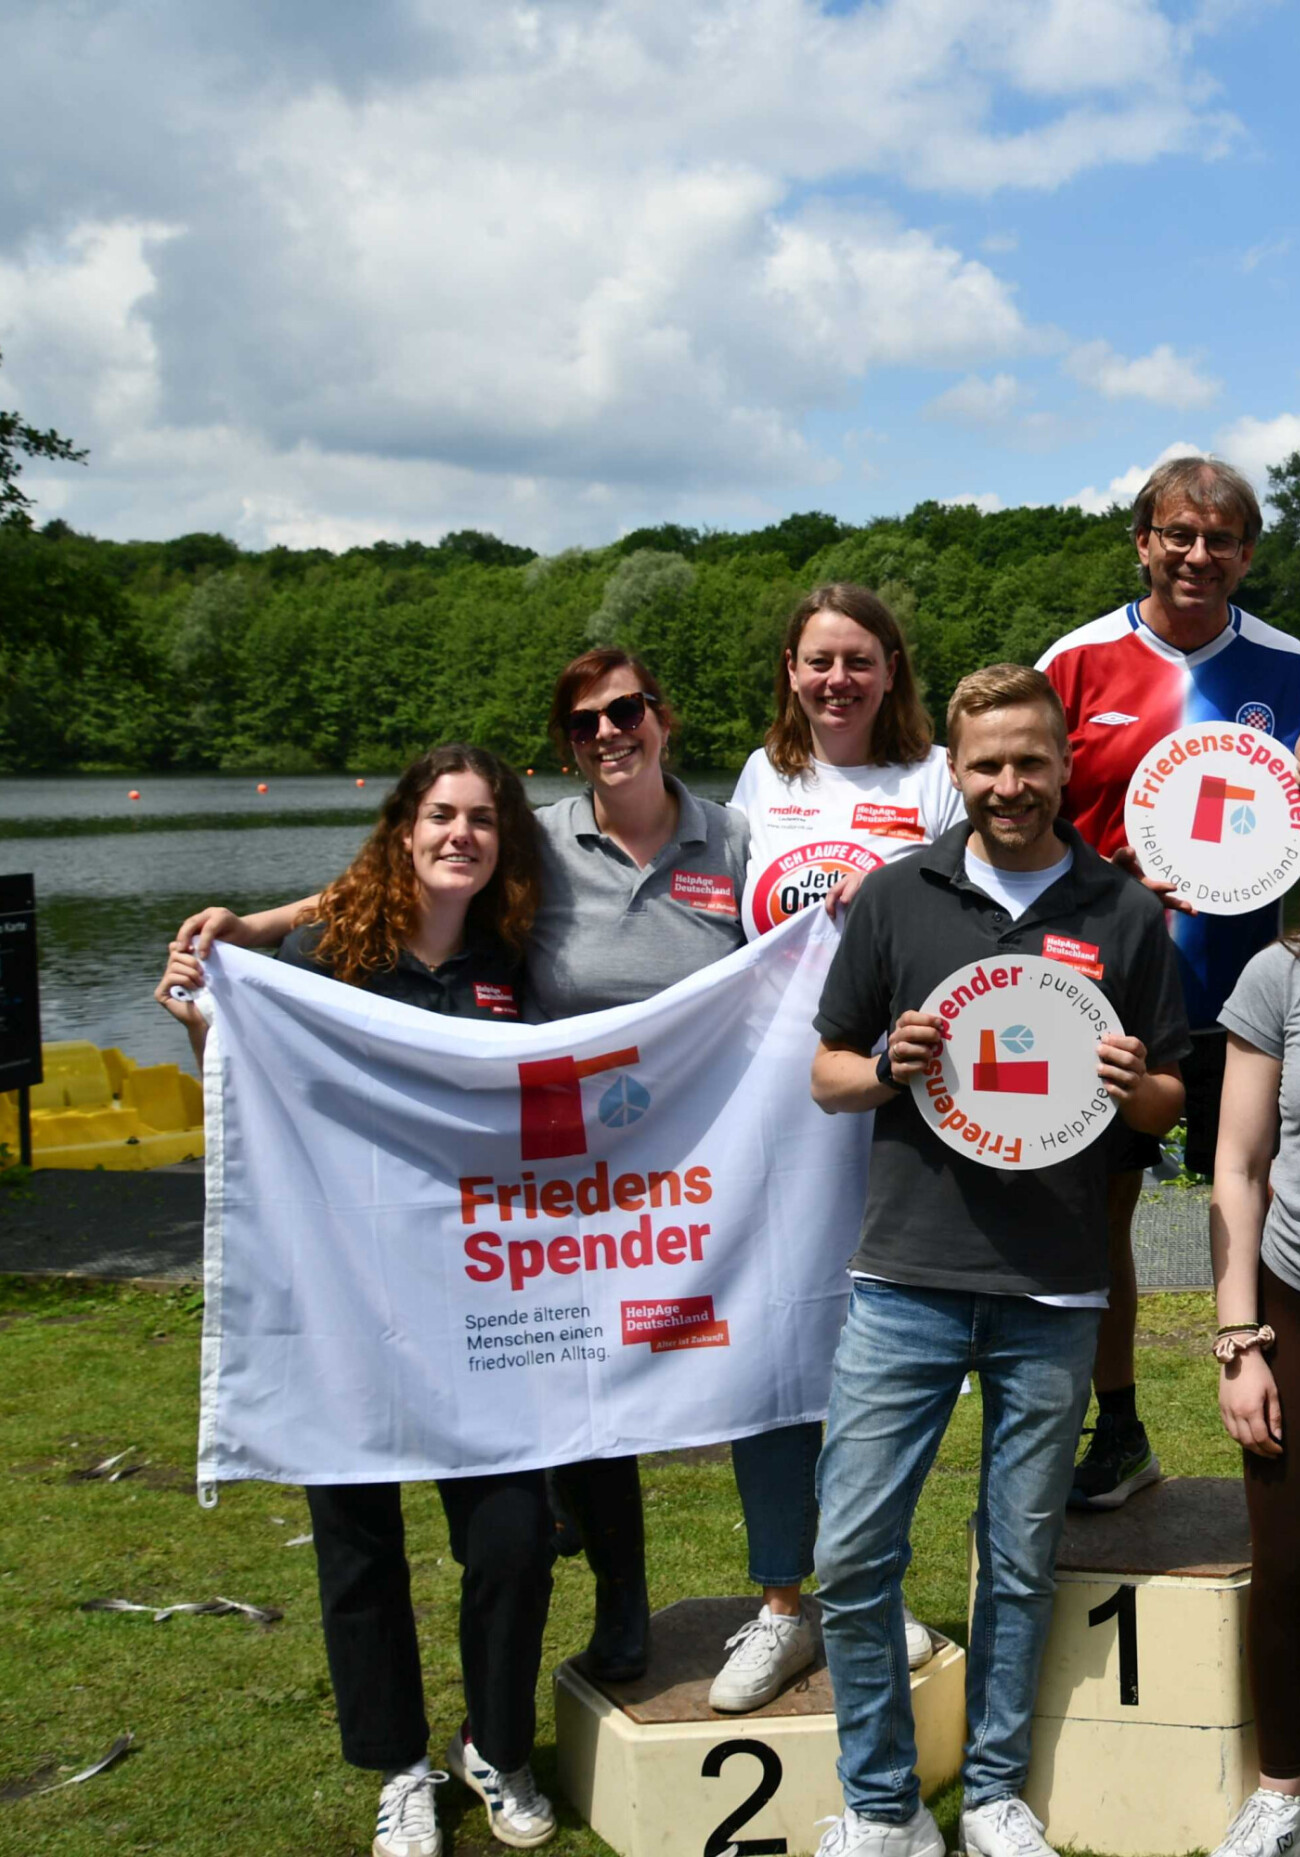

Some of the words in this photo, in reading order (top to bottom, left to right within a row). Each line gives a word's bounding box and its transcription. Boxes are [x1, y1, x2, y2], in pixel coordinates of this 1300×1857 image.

[855, 813, 915, 824] Deutschland
[856, 805, 897, 816] HelpAge
[778, 853, 803, 872] ICH
[806, 844, 850, 861] LAUFE
[848, 847, 878, 872] FÜR
[675, 874, 714, 886] HelpAge
[800, 870, 846, 889] Jed
[1197, 846, 1298, 903] Deutschland
[675, 883, 731, 896] Deutschland
[1046, 944, 1095, 961] Deutschland
[1047, 938, 1080, 950] HelpAge
[1041, 1087, 1109, 1150] HelpAge
[459, 1161, 713, 1224] Friedens
[464, 1214, 711, 1291] Spender
[465, 1309, 529, 1331] Spende
[534, 1305, 591, 1324] älteren
[625, 1303, 680, 1318] HelpAge
[625, 1311, 709, 1332] Deutschland
[467, 1329, 555, 1351] Menschen
[559, 1324, 604, 1341] einen
[656, 1340, 677, 1350] Alter
[679, 1336, 689, 1346] ist
[690, 1332, 725, 1345] Zukunft
[468, 1349, 555, 1372] friedvollen
[560, 1344, 611, 1363] Alltag.
[1088, 1584, 1139, 1706] 1
[701, 1738, 788, 1857] 2
